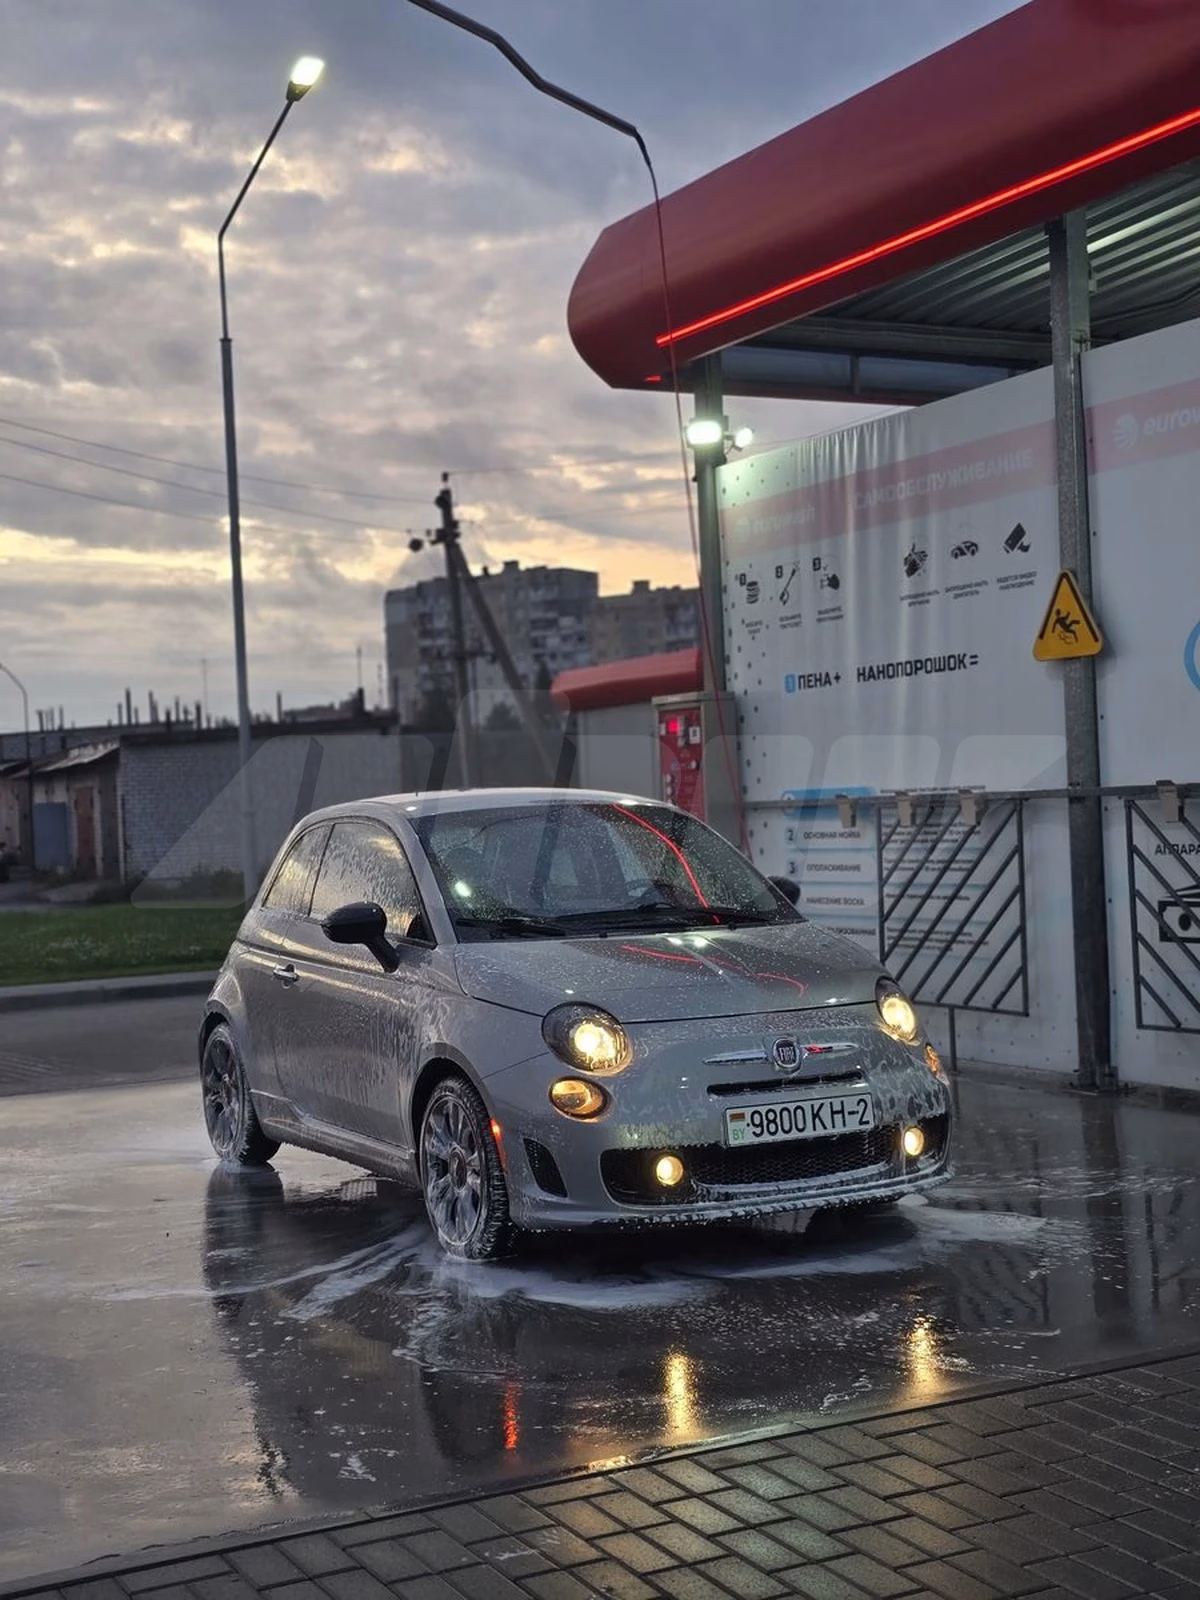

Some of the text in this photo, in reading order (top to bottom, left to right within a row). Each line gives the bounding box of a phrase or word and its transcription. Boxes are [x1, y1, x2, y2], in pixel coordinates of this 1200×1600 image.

[856, 448, 1034, 510] САМООБСЛУЖИВАНИЕ
[797, 653, 980, 691] ПЕНА+ НАНОПОРОШОК=
[788, 861, 796, 874] 3
[732, 1127, 746, 1141] BY
[750, 1098, 870, 1138] 9800 KH-2
